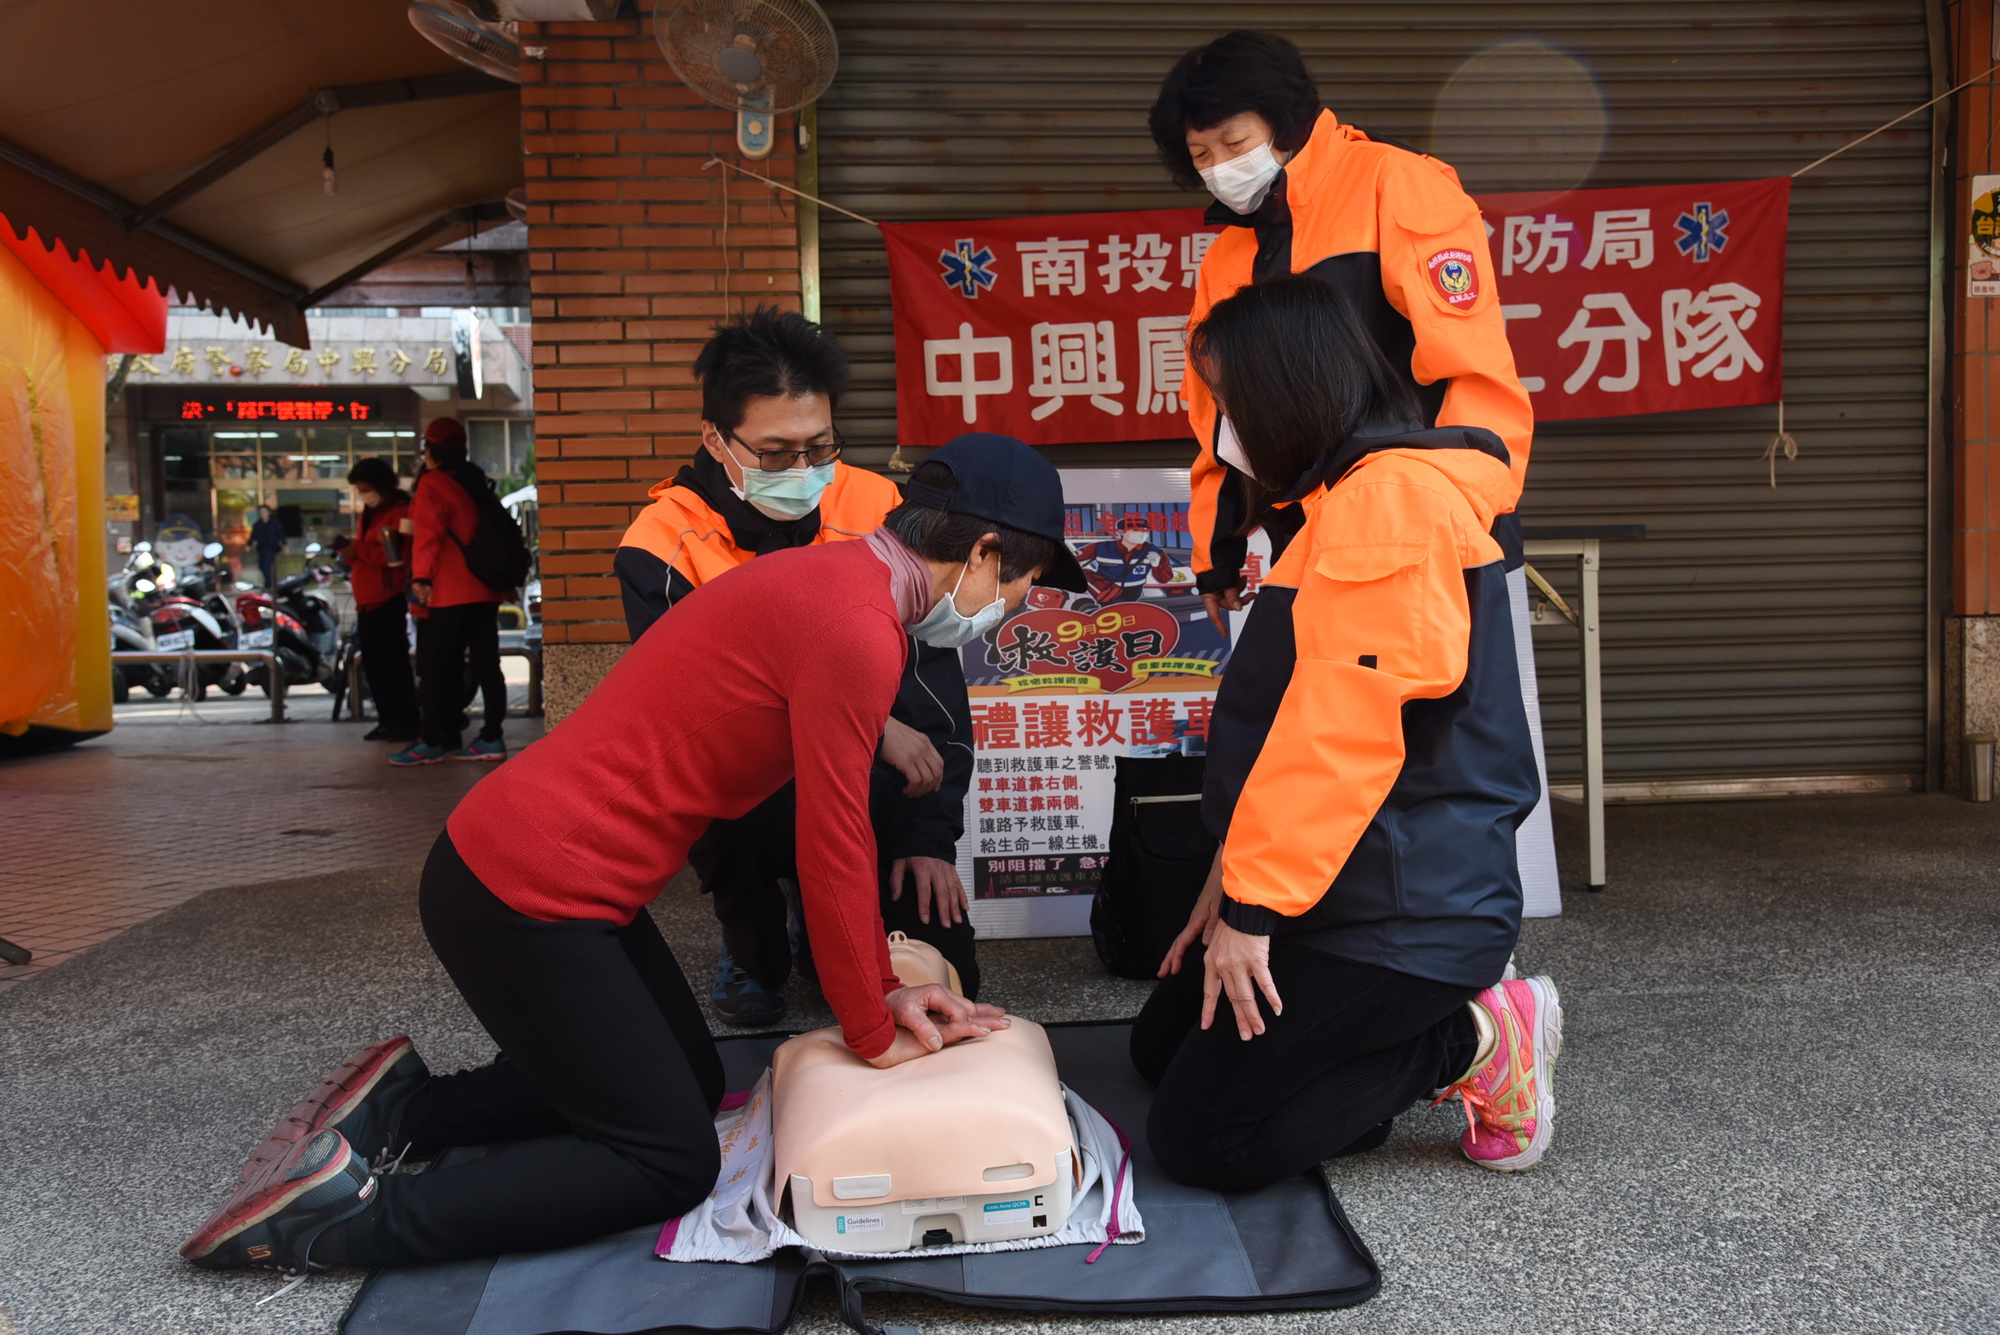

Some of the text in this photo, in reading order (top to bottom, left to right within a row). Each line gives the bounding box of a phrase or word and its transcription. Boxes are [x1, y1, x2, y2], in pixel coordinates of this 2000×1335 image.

[1487, 208, 1655, 277] 防局
[1057, 612, 1136, 642] 9月9日
[1000, 625, 1163, 672] 救護日
[970, 697, 1216, 750] 禮讓救護車
[988, 857, 1066, 873] 別阻擋了
[847, 1217, 880, 1225] Guidelines
